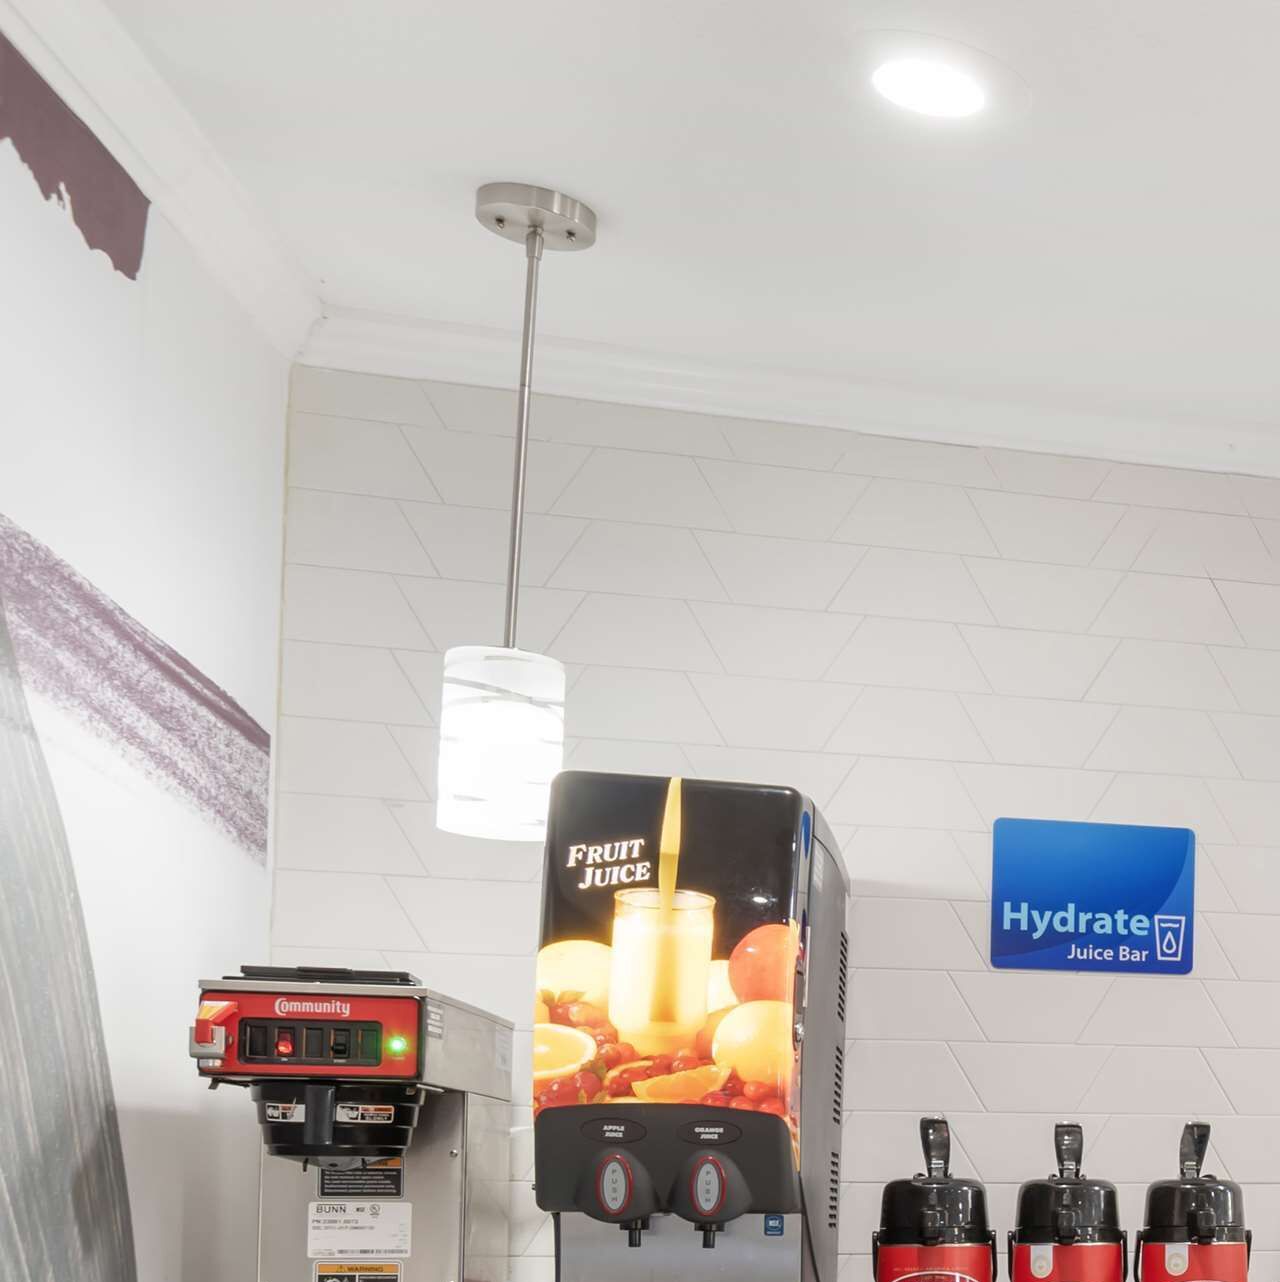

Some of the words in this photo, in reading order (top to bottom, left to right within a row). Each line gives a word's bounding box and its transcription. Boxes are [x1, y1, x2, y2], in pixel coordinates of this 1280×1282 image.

[566, 838, 646, 868] FRUIT
[578, 861, 651, 890] JUICE
[1002, 901, 1150, 940] Hydrate
[1067, 944, 1115, 961] Juice
[1119, 946, 1149, 962] Bar
[274, 997, 351, 1018] Community
[316, 1203, 347, 1214] BUNN
